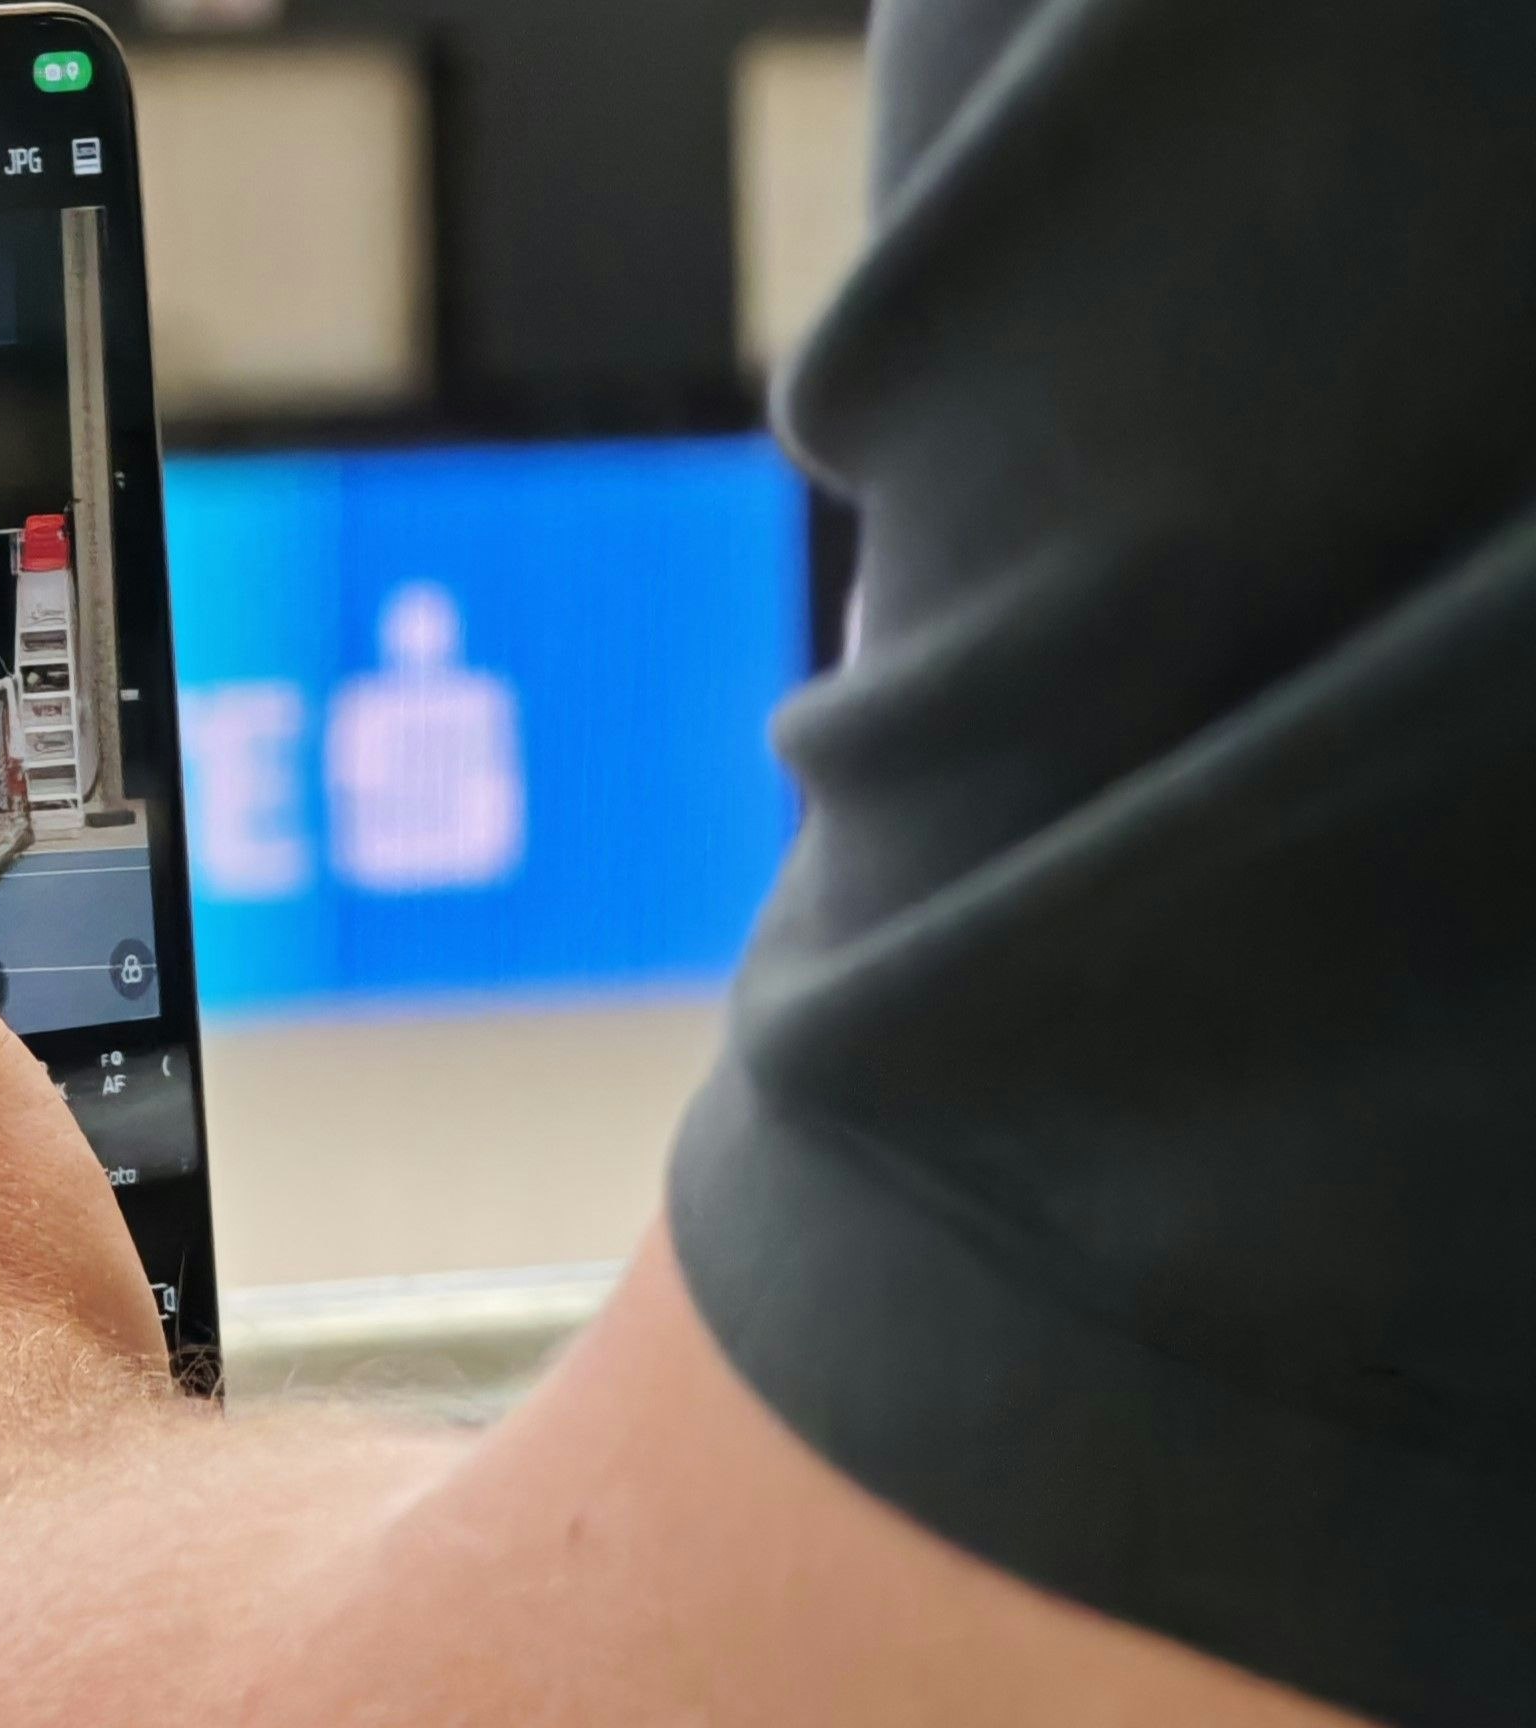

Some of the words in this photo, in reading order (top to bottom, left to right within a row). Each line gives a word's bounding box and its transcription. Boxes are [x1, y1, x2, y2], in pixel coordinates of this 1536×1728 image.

[4, 147, 43, 175] JPG
[102, 1074, 126, 1096] AF
[104, 1166, 136, 1186] oto
